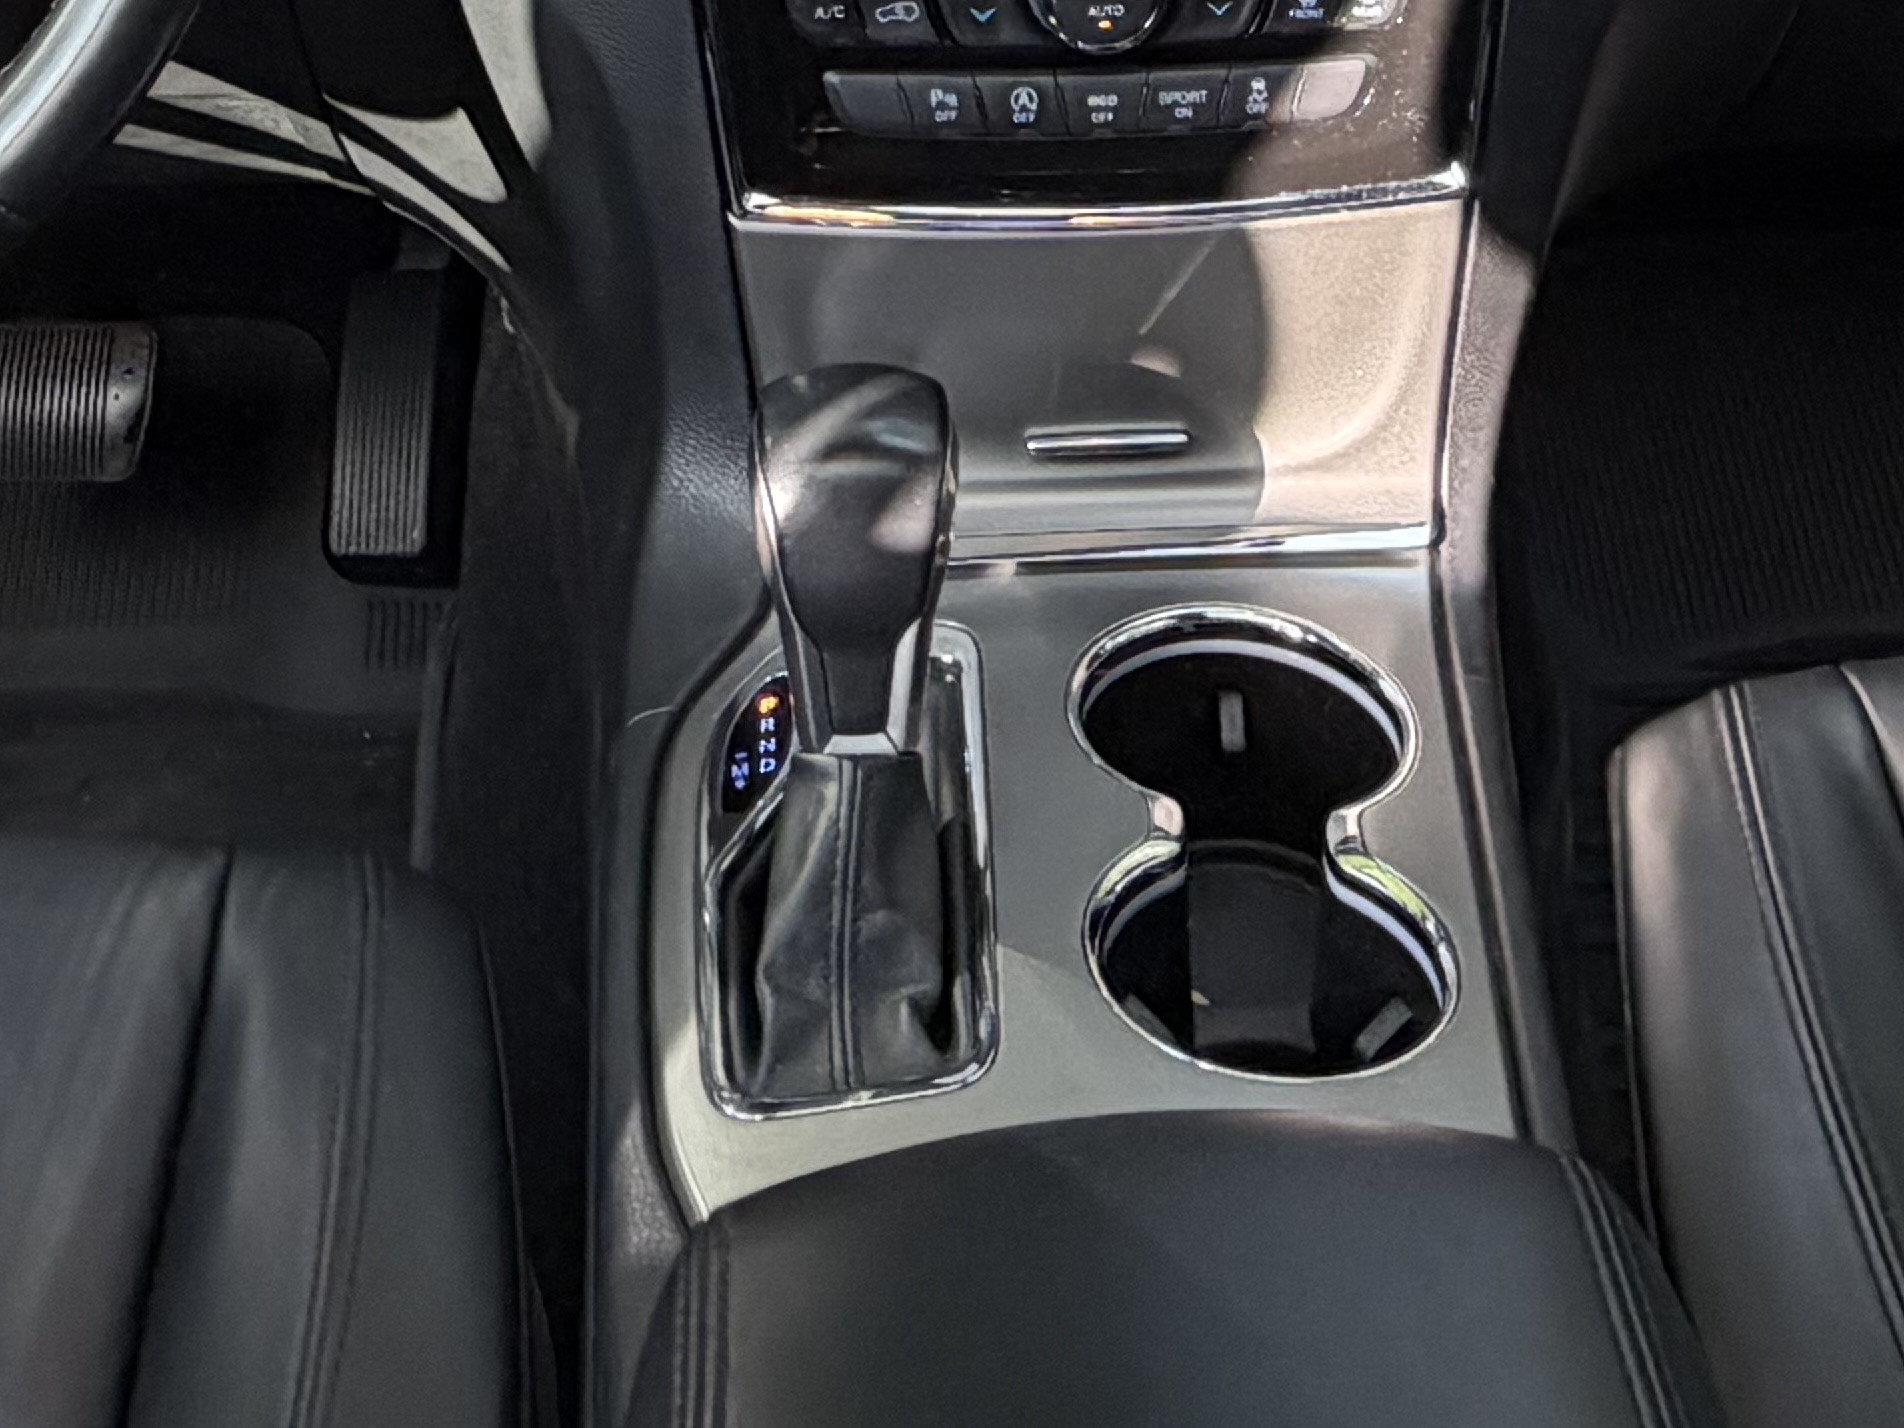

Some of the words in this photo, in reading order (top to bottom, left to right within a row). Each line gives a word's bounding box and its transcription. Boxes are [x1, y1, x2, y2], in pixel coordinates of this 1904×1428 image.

[814, 5, 846, 20] A/C
[1088, 4, 1125, 18] AUTO
[1158, 89, 1208, 107] SPORT
[934, 110, 960, 124] OFF
[1012, 110, 1037, 124] OFF
[1174, 107, 1195, 120] ON
[759, 696, 780, 715] P
[760, 717, 776, 734] R
[758, 736, 777, 754] N
[758, 757, 777, 775] D
